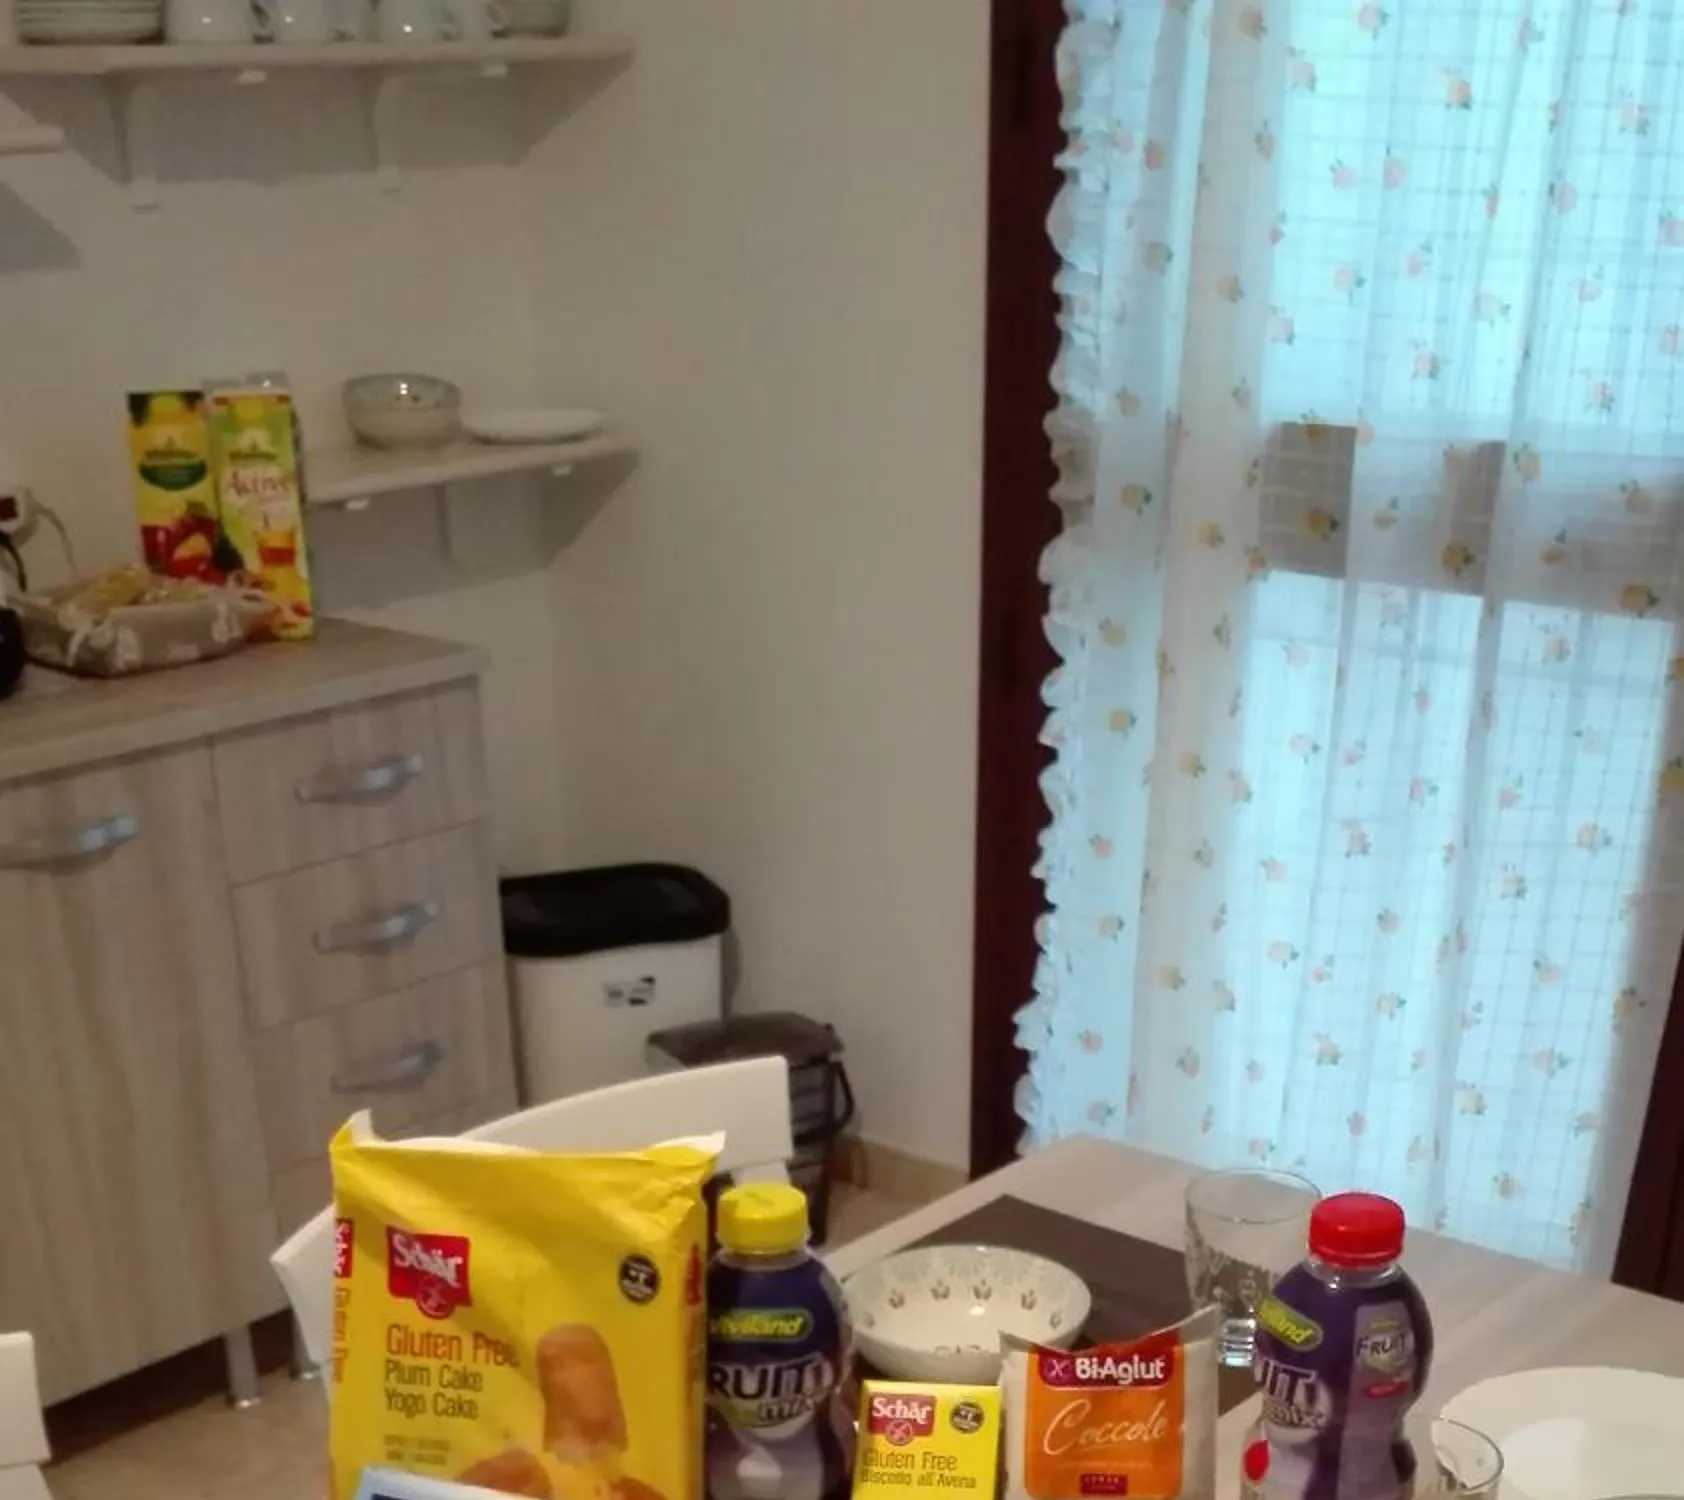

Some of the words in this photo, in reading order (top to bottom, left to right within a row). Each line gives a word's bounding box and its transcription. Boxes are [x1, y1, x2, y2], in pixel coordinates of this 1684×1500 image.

[386, 1323, 463, 1362] Gluten
[472, 1331, 521, 1369] Free
[384, 1359, 431, 1388] Plum
[438, 1363, 484, 1393] Cake
[708, 1352, 825, 1400] RUITI
[384, 1387, 427, 1419] Yogo
[432, 1392, 480, 1420] Cake
[864, 1449, 915, 1469] Gluten
[921, 1450, 958, 1471] Free
